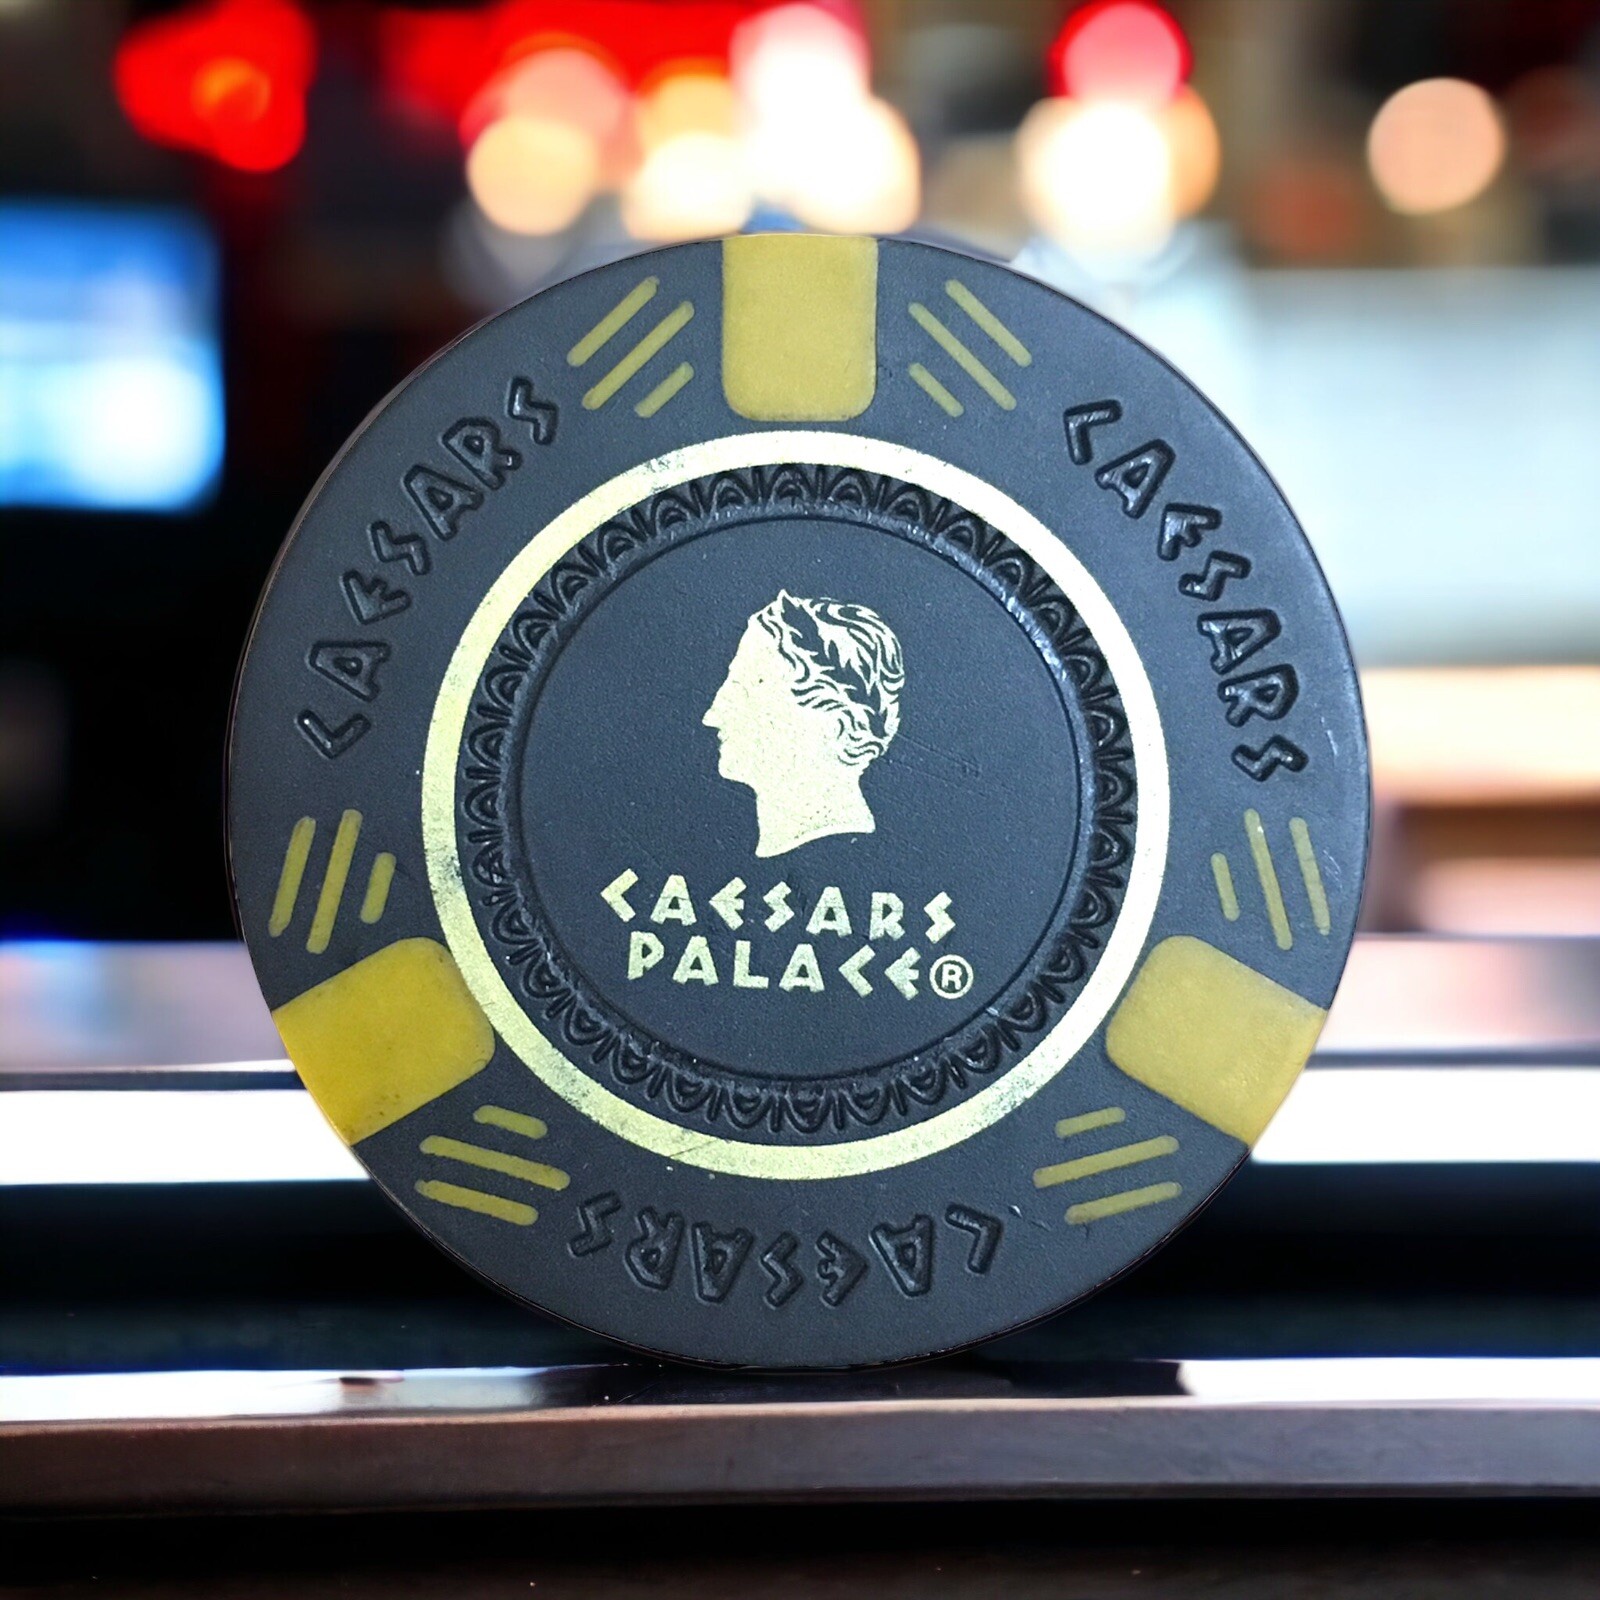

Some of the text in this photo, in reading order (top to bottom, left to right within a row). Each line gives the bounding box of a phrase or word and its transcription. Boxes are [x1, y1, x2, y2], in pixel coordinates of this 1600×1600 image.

[295, 375, 559, 760] CAESARS
[1062, 399, 1309, 783] CAESARS
[600, 868, 956, 944] CAESARS
[568, 1190, 1003, 1308] CAESARS
